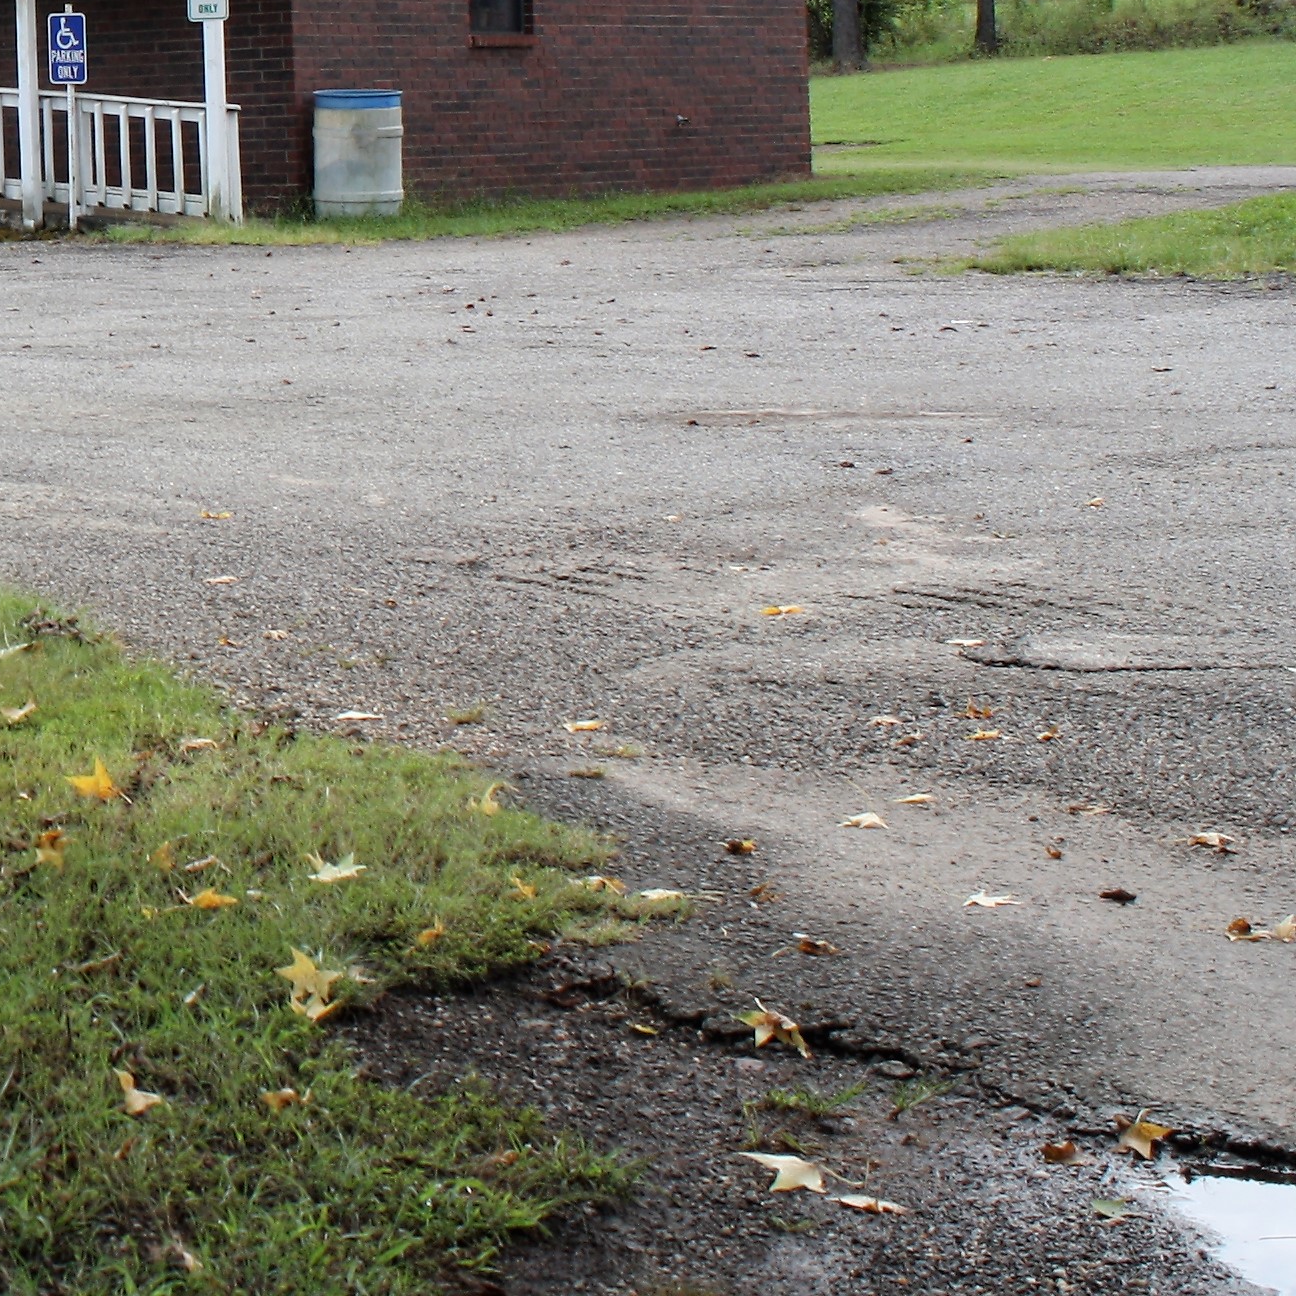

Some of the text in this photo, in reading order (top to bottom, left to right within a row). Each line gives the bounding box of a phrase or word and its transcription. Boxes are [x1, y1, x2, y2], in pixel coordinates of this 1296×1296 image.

[198, 4, 218, 14] ONLY
[51, 49, 84, 63] PARKING
[57, 65, 79, 79] ONLY
